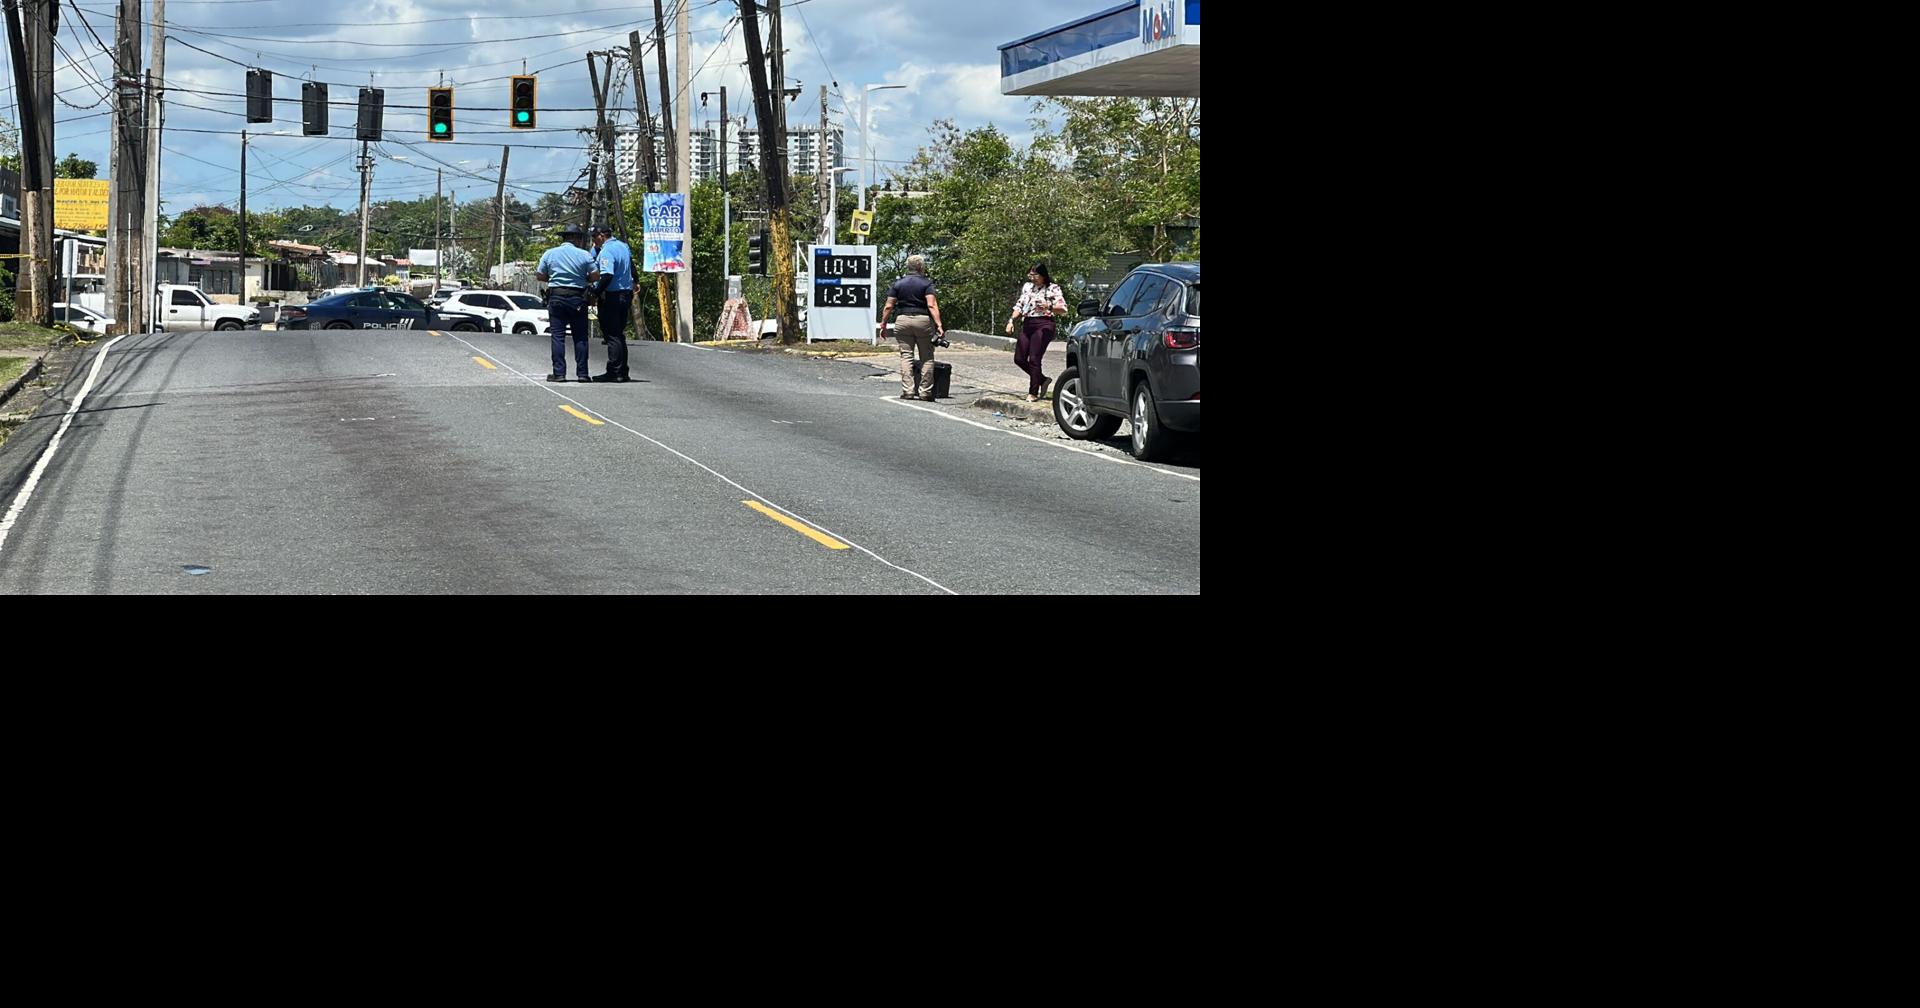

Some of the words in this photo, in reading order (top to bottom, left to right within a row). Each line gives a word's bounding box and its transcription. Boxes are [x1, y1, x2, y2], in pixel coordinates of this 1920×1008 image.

[1142, 0, 1174, 44] Mobil
[648, 206, 681, 217] CAR
[648, 218, 680, 227] WASH
[824, 259, 869, 275] 1.047
[824, 287, 868, 304] 1.257
[363, 322, 406, 330] POLICIA
